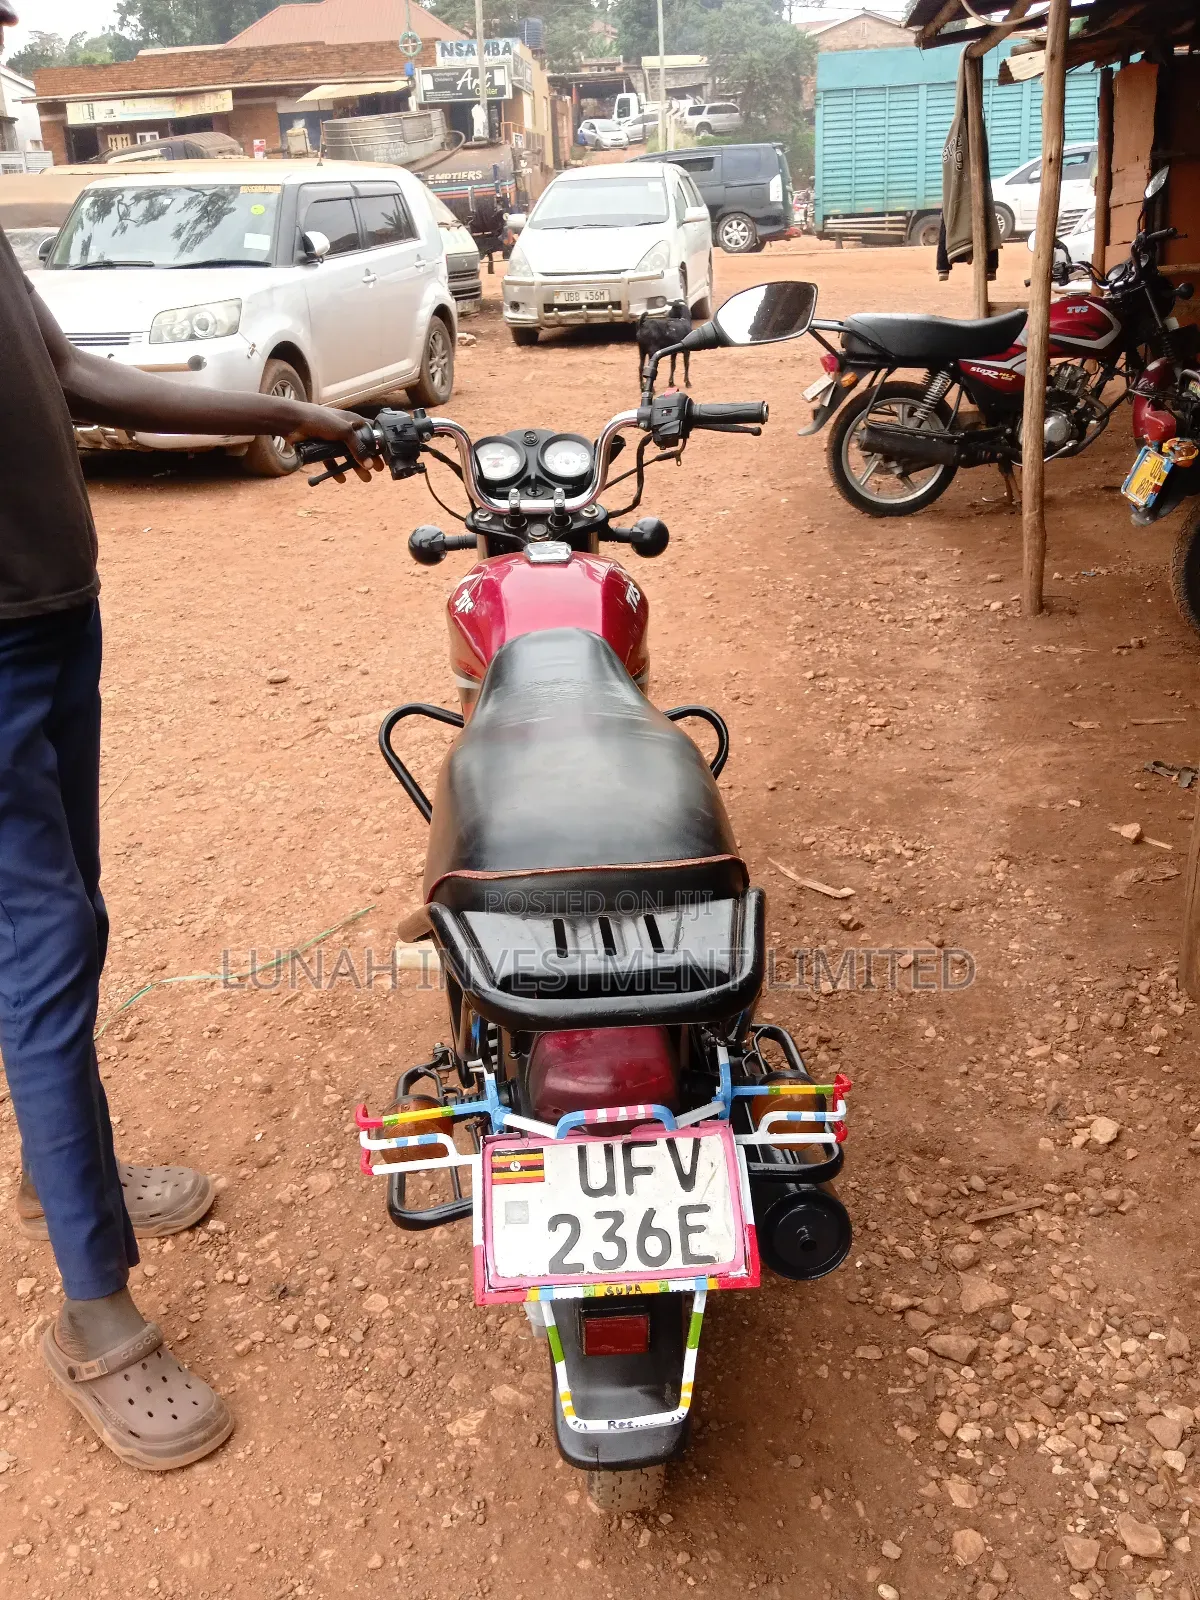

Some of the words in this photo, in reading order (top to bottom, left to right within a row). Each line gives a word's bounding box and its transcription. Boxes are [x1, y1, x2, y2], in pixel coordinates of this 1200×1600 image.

[475, 87, 498, 96] Cnter
[1066, 305, 1089, 314] TVS
[577, 1137, 701, 1199] UFV
[547, 1203, 716, 1275] 236E
